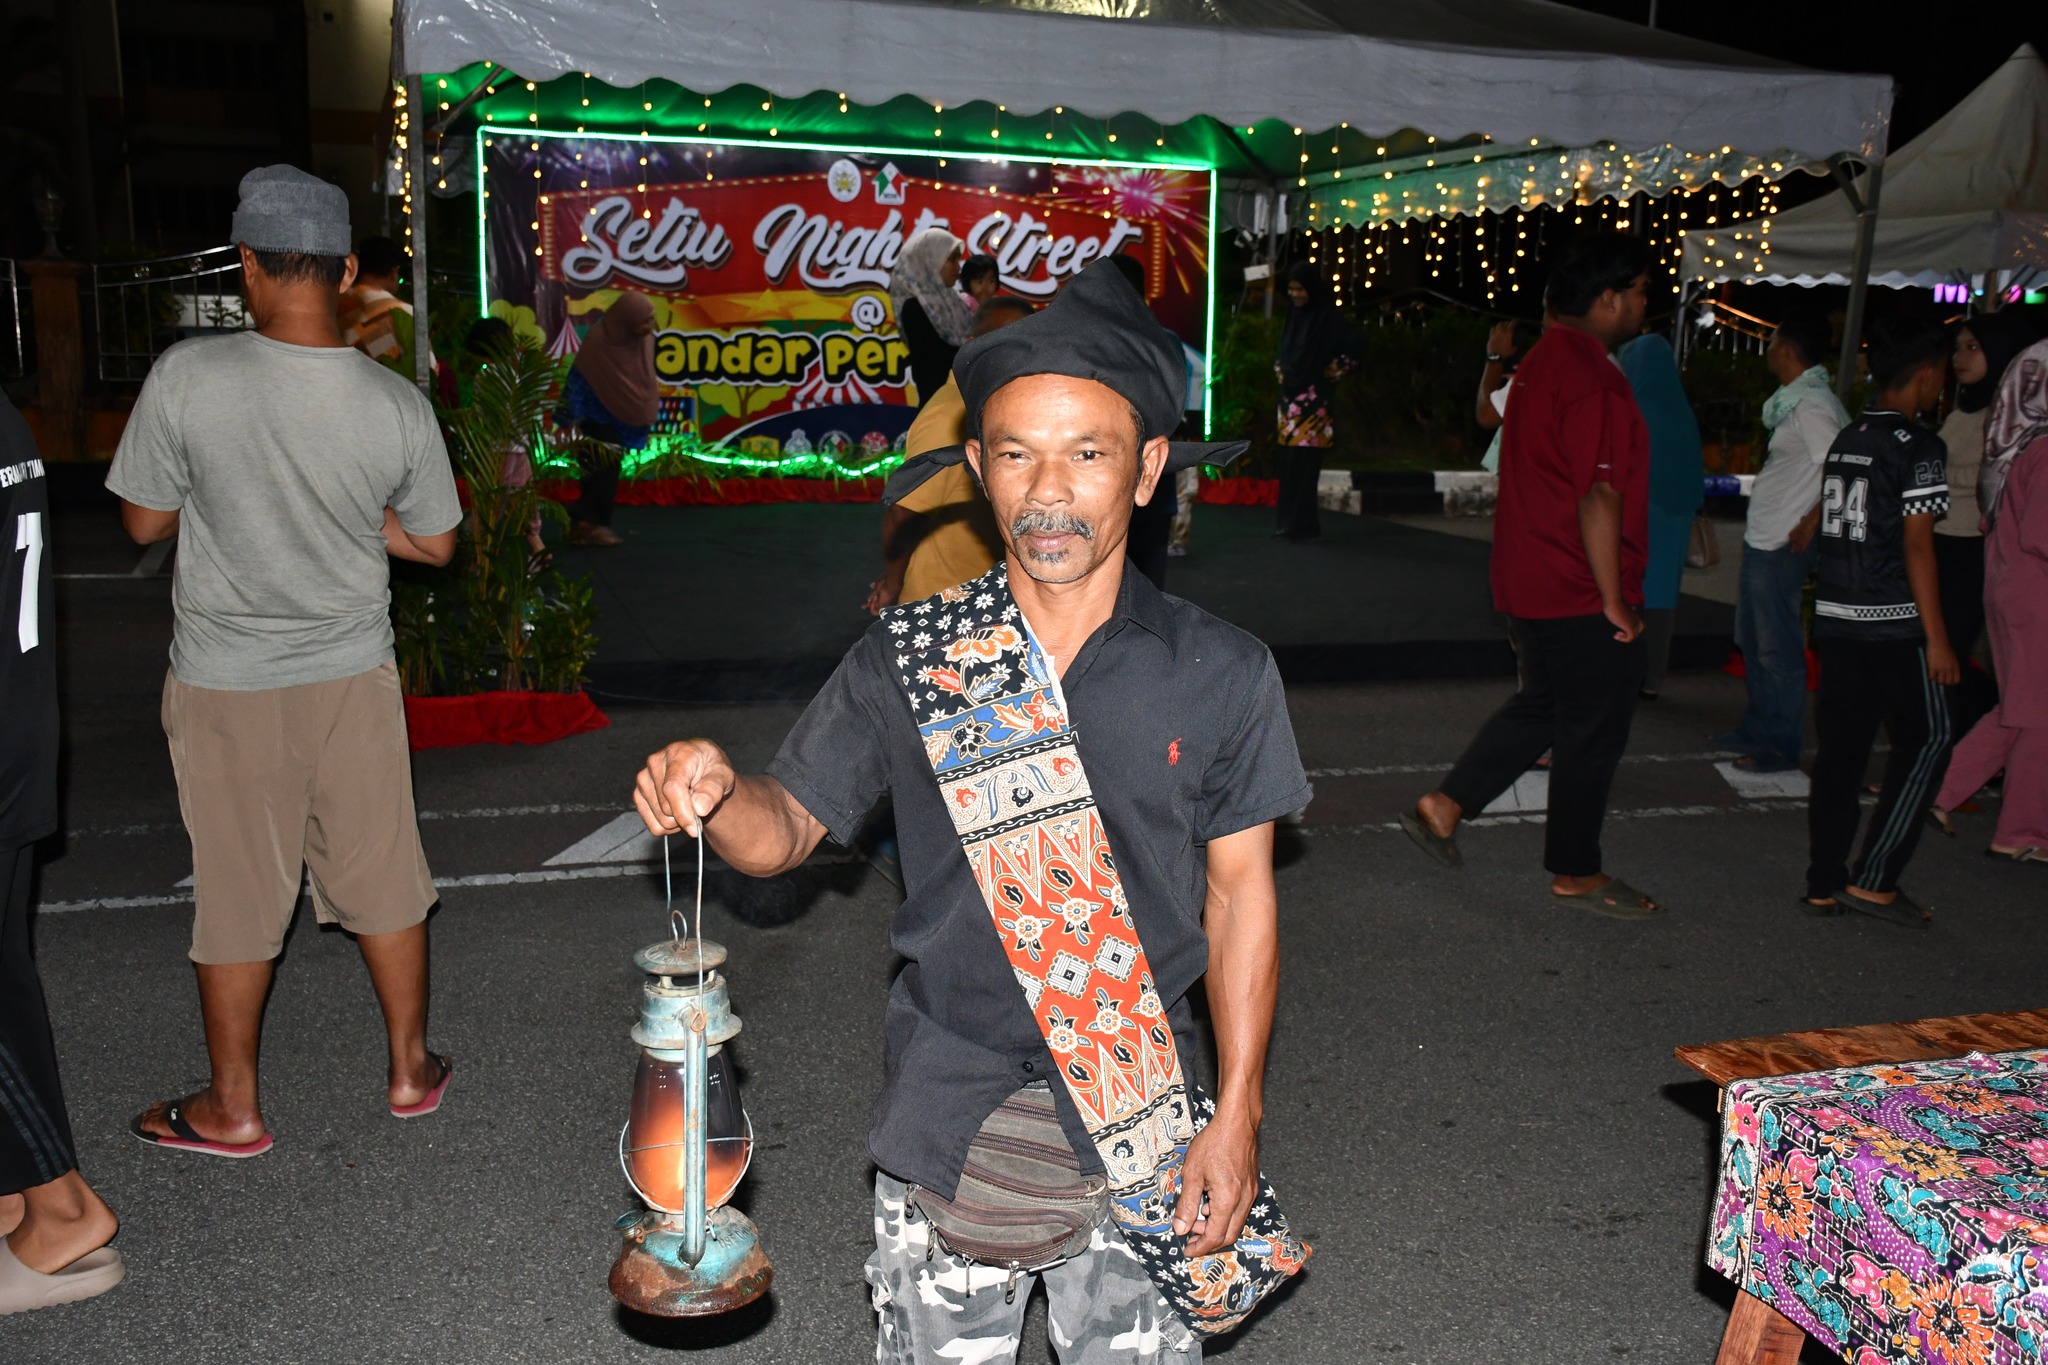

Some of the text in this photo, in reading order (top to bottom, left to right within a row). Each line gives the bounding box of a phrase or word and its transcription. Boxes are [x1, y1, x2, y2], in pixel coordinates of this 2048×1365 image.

[562, 196, 732, 286] Setiu
[851, 295, 886, 332] @
[653, 333, 912, 379] andar Per
[1915, 459, 1947, 486] 24
[1821, 474, 1869, 542] 24
